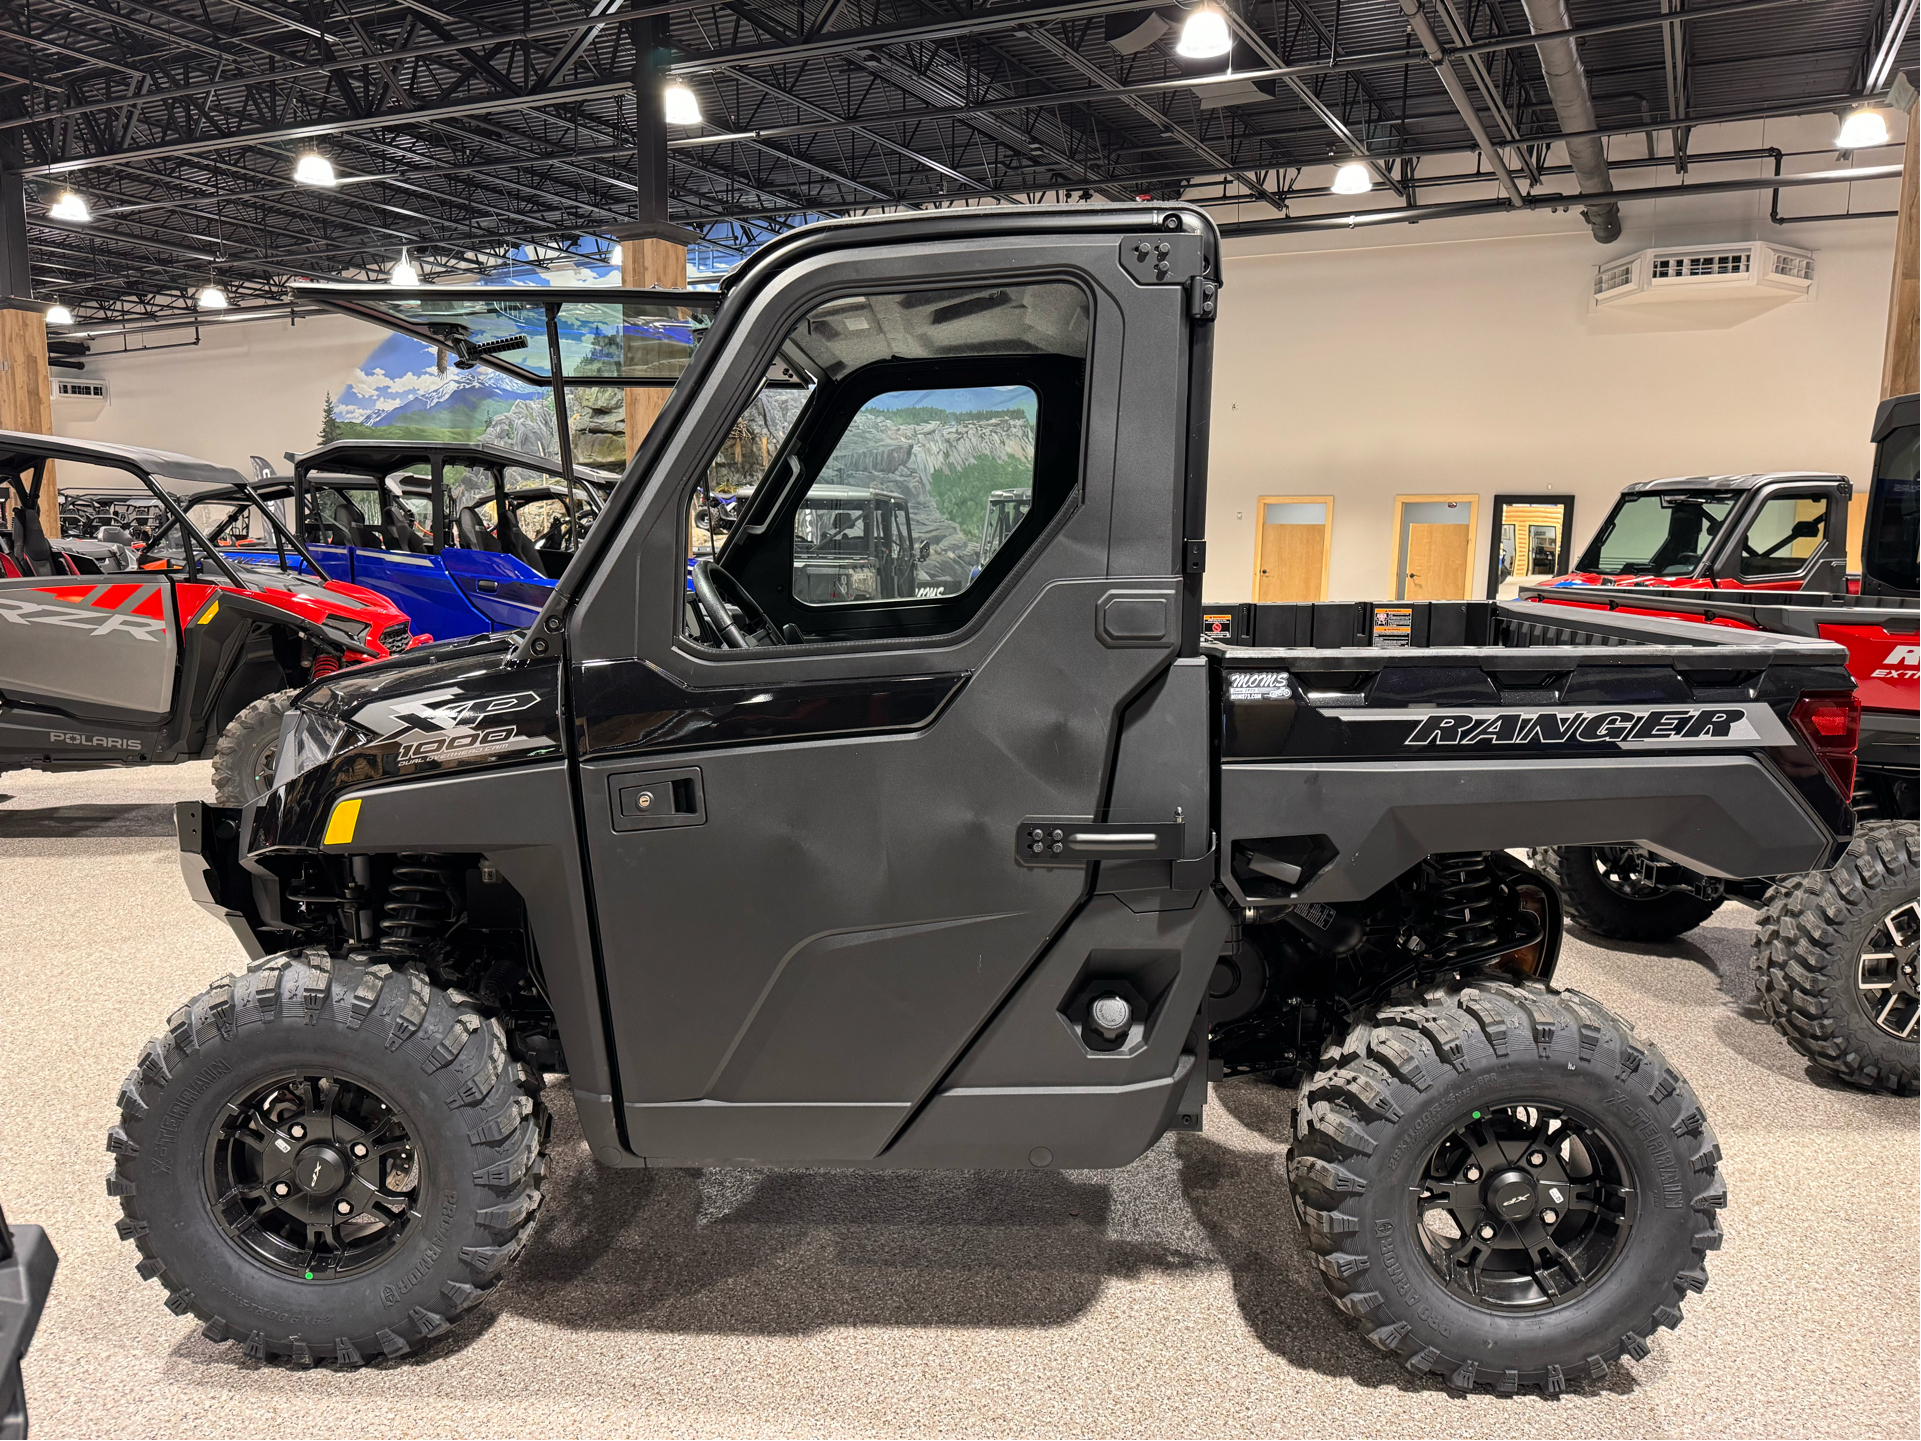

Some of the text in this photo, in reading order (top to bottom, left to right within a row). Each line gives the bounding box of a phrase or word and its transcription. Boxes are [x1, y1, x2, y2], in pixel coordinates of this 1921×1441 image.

[0, 598, 166, 643] RZR
[1231, 673, 1289, 688] MOMS
[50, 731, 142, 751] POLARIS
[397, 725, 517, 762] 1000
[1404, 708, 1747, 745] RANGER
[398, 757, 424, 767] DUAL
[425, 747, 483, 762] OVERHEAD
[484, 743, 509, 753] CAM
[151, 1057, 233, 1175] X-TERRAIN
[1603, 1088, 1684, 1210] X-TERRAIN
[396, 1189, 459, 1295] PRO ARMOR
[1380, 1238, 1452, 1340] PRO ARMOR
